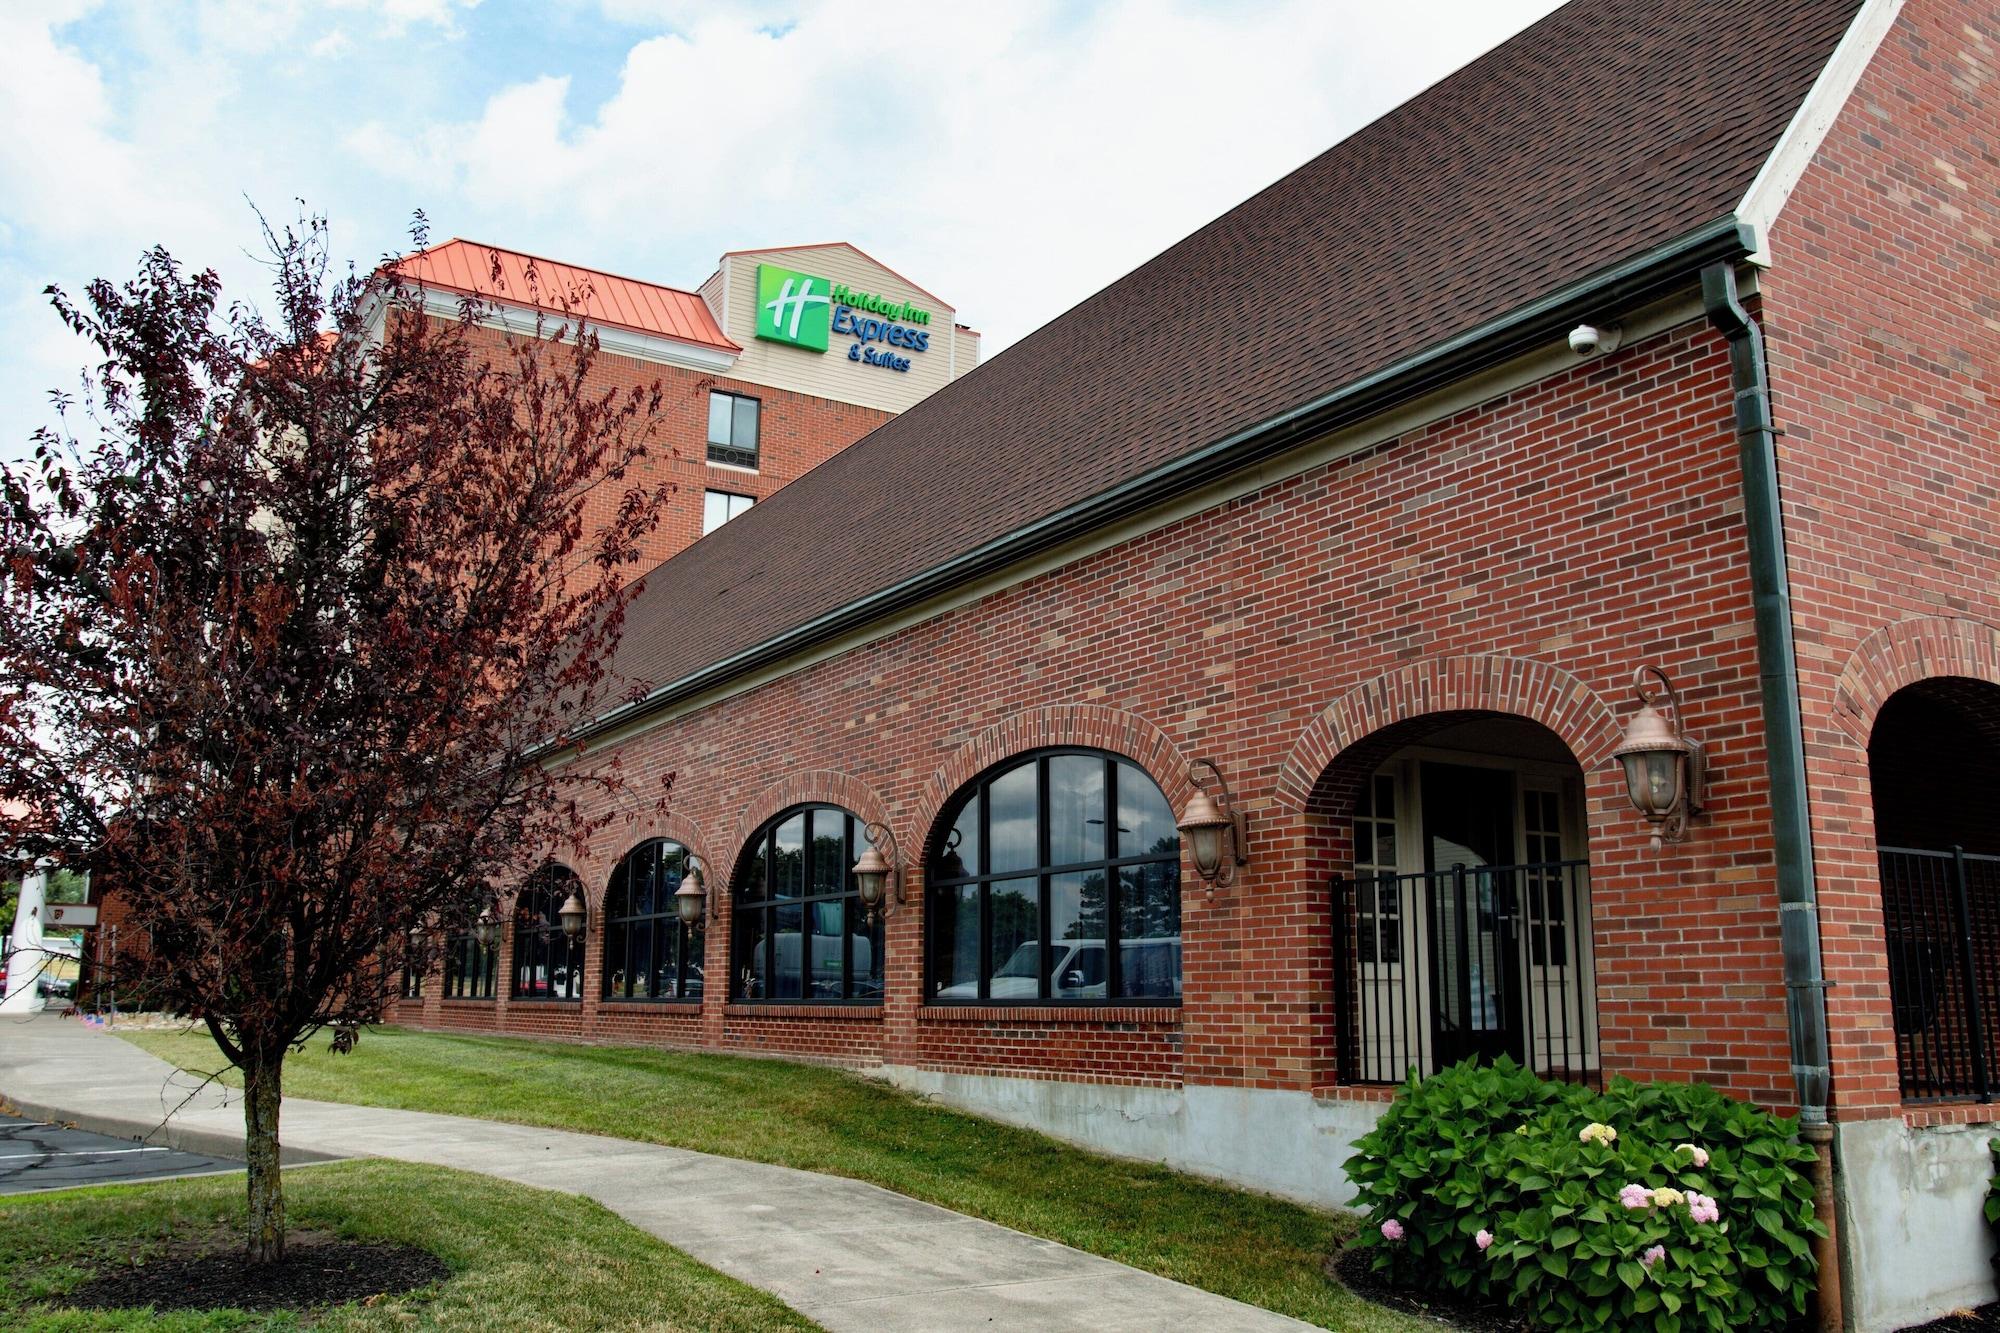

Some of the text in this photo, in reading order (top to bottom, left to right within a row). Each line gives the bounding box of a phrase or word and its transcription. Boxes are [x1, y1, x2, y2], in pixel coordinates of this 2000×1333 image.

[832, 284, 931, 325] Holiday Inn
[831, 305, 930, 352] Express
[848, 343, 911, 372] & Suites
